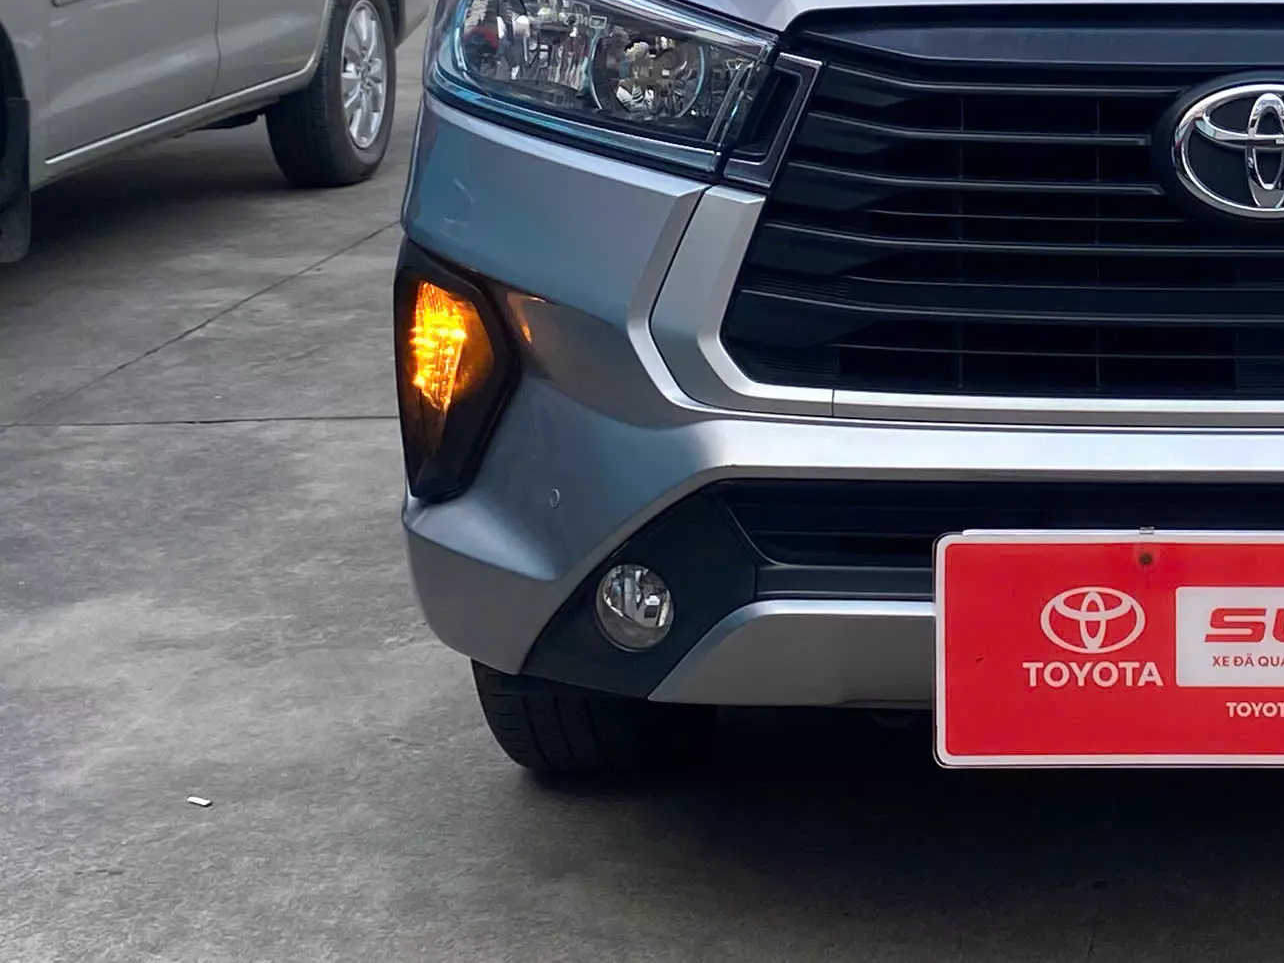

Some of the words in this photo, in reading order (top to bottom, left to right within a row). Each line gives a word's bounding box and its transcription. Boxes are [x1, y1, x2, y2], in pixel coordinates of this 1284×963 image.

[1212, 655, 1229, 667] XE
[1233, 653, 1253, 668] ĐÃ
[1022, 661, 1164, 687] TOYOTA
